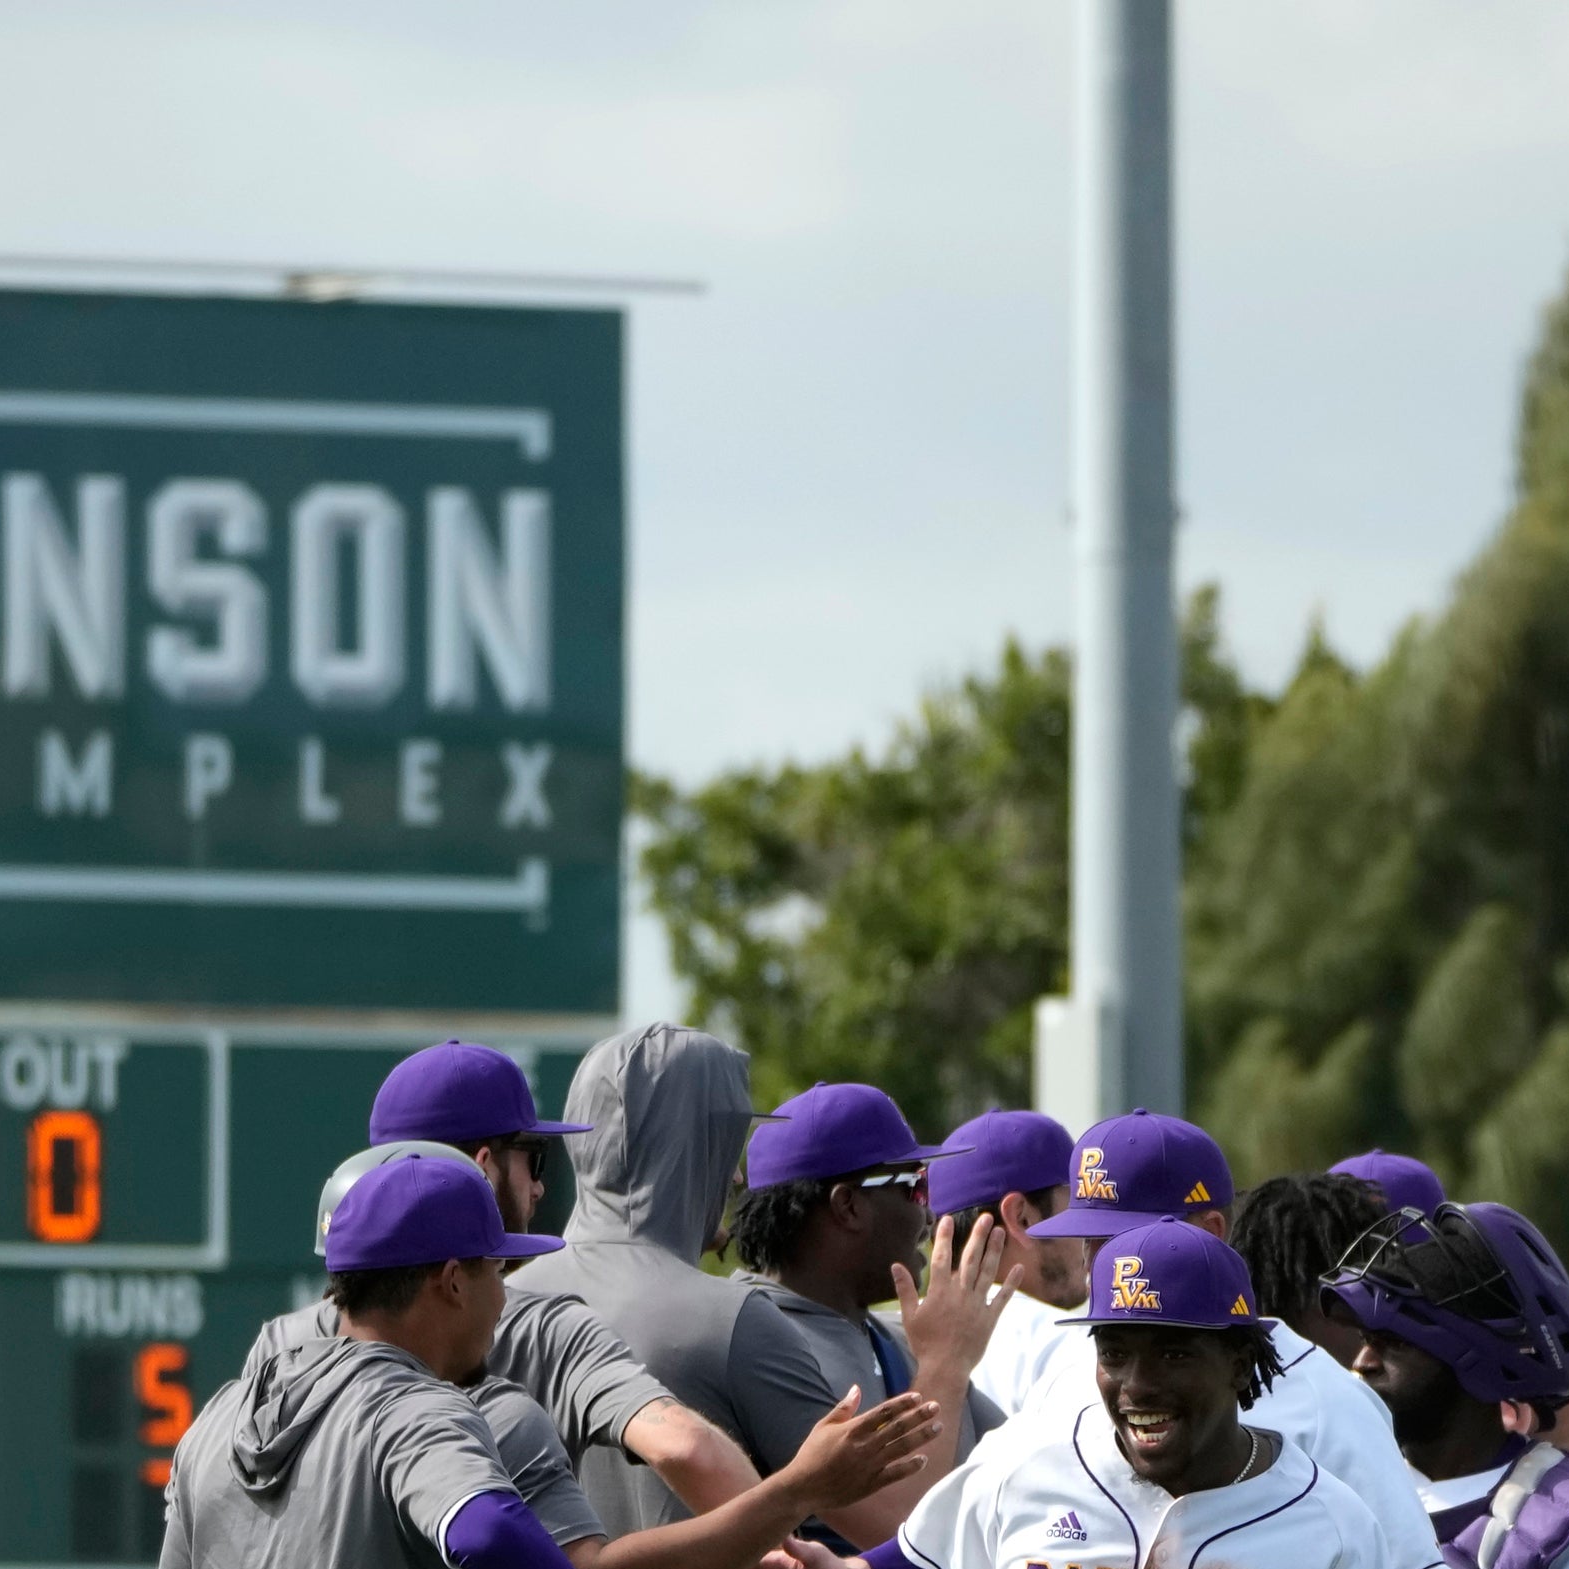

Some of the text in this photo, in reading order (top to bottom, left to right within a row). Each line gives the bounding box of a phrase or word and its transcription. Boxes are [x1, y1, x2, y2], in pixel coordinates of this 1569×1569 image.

[29, 1109, 101, 1242] 0
[57, 1274, 204, 1338] RUNS
[1540, 1324, 1563, 1369] EASTON
[1046, 1526, 1087, 1541] adidas
